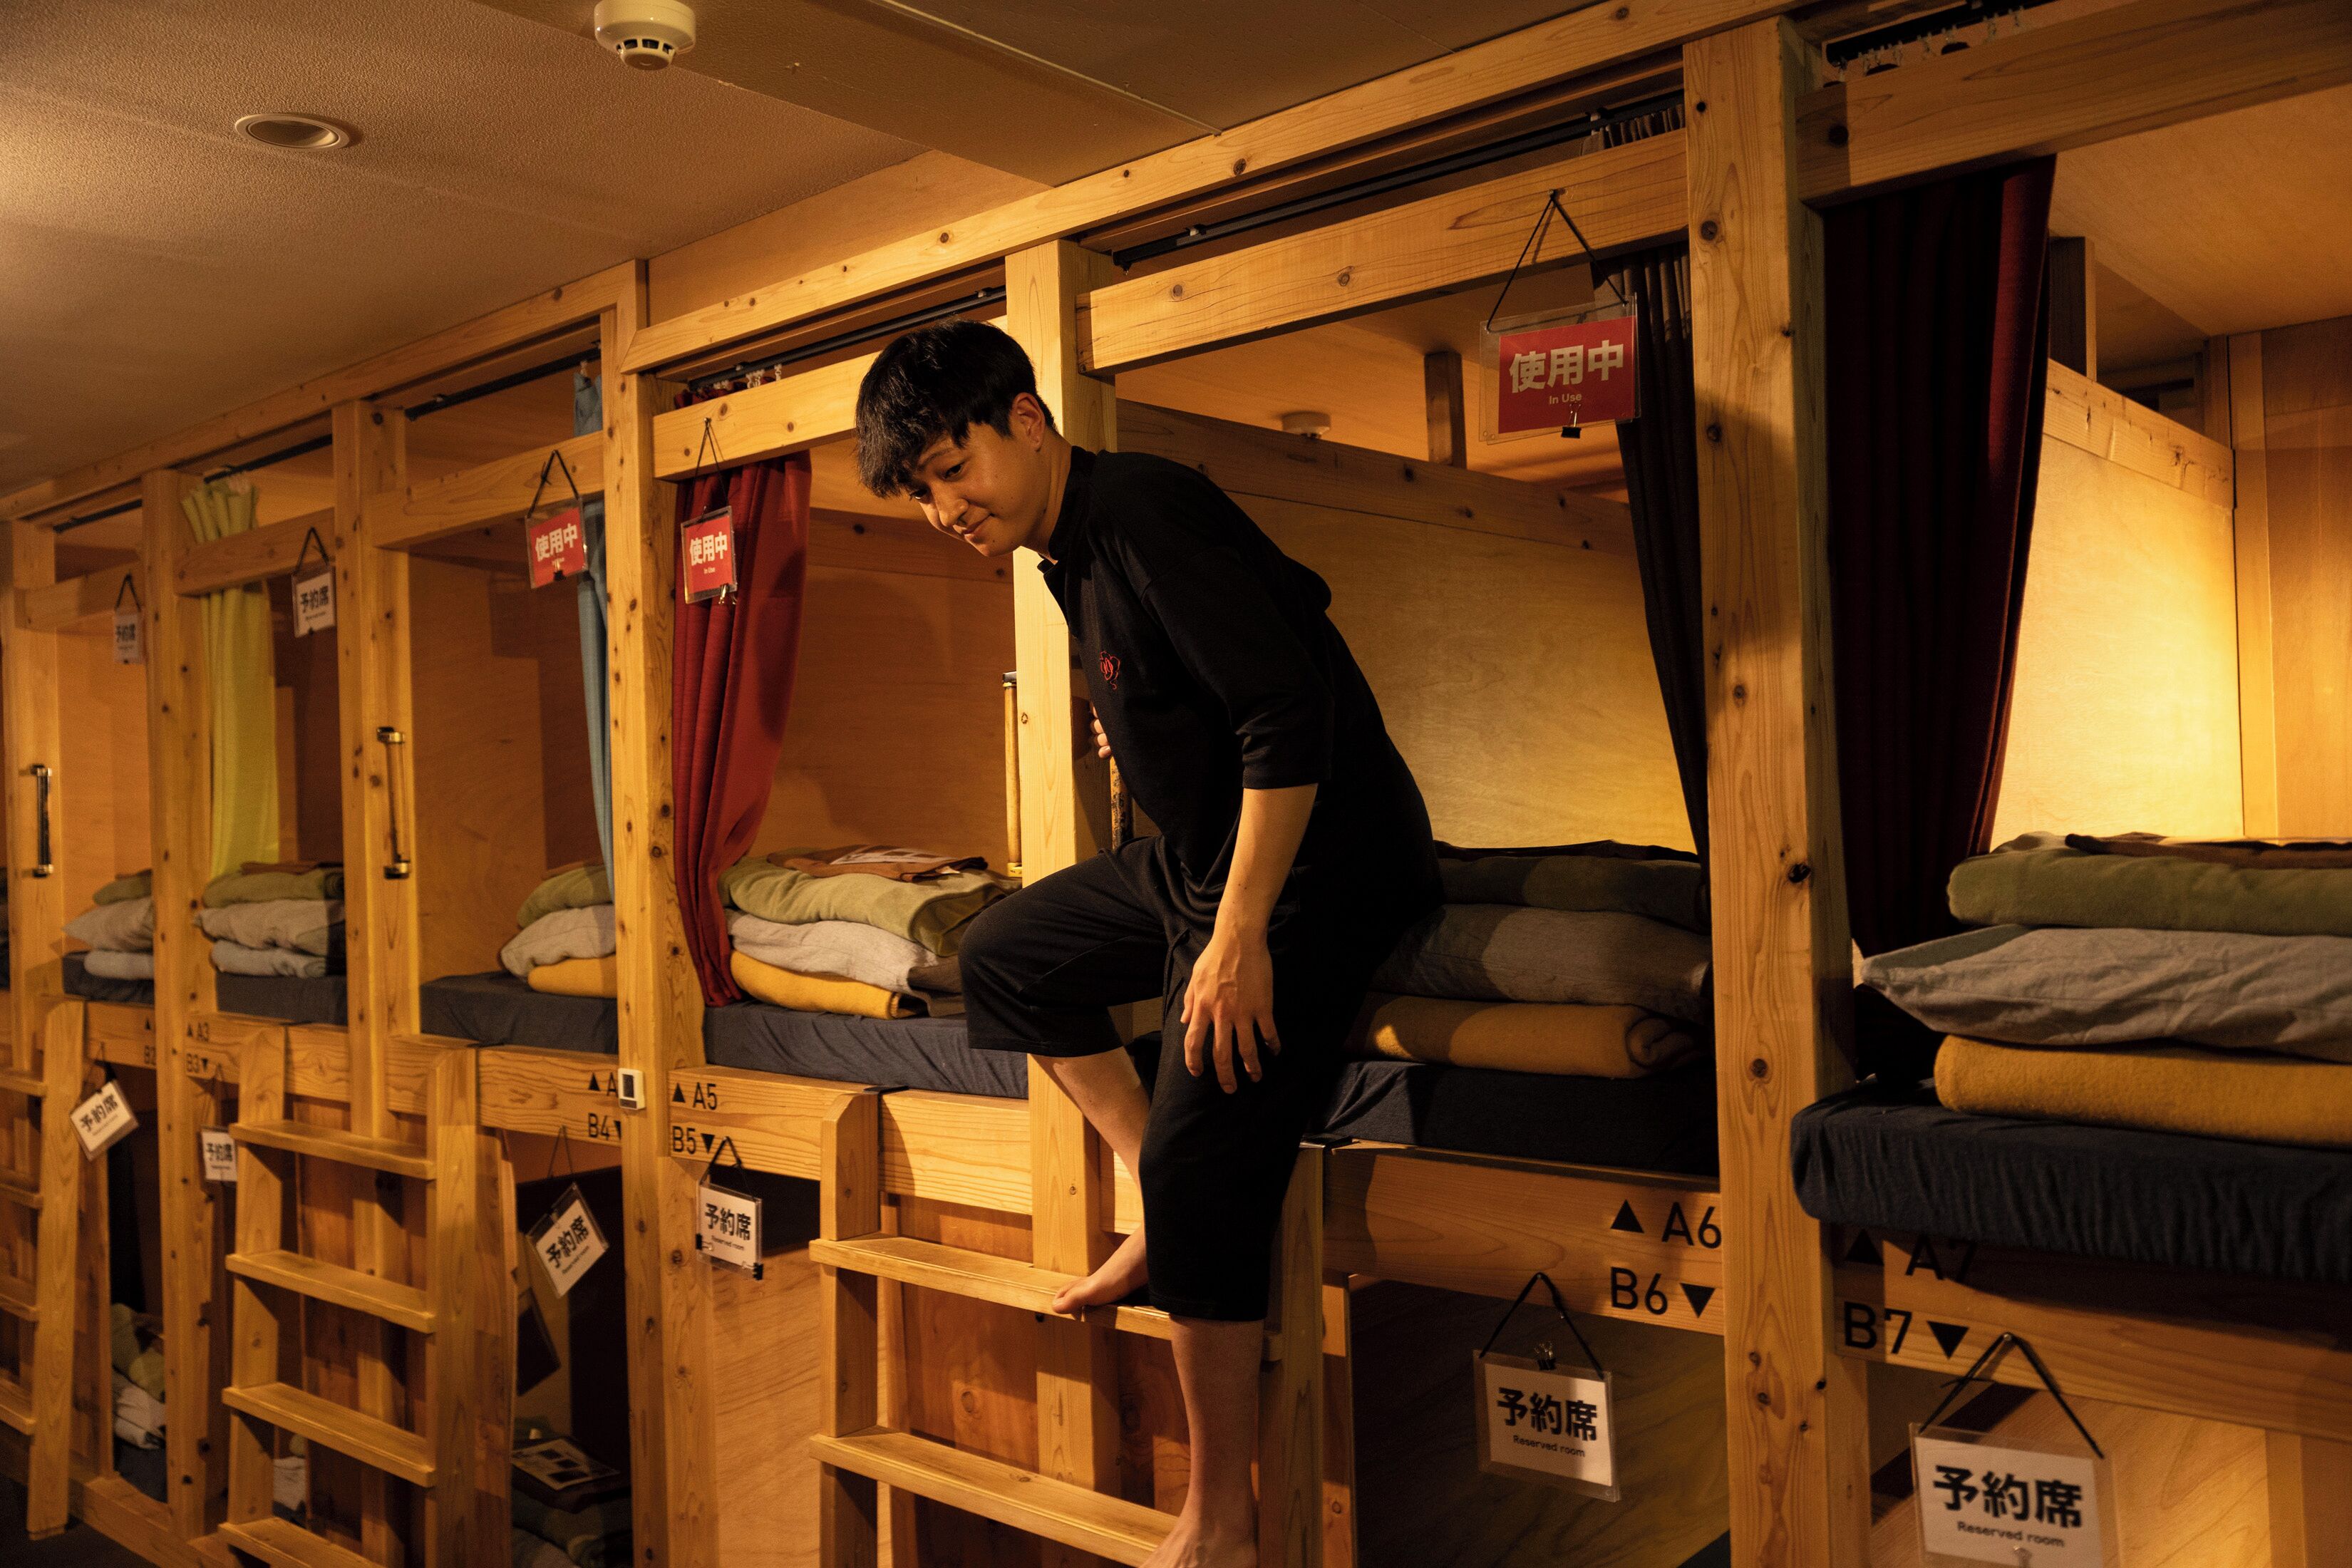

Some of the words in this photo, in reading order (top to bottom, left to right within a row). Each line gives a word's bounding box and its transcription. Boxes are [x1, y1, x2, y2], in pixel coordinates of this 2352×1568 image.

[1509, 339, 1624, 393] 使用中
[1549, 396, 1559, 405] In
[1562, 393, 1582, 403] Use
[535, 523, 578, 562] 使用中
[689, 531, 728, 566] 使用中
[607, 1072, 619, 1098] A
[693, 1082, 718, 1110] A5
[80, 1093, 118, 1132] 予約席
[588, 1113, 610, 1140] B4
[673, 1125, 697, 1154] B5
[705, 1202, 751, 1241] 予約席
[1661, 1202, 1722, 1249] A6
[547, 1215, 589, 1268] 予約席
[1906, 1234, 1977, 1284] A7
[1611, 1267, 1668, 1315] B6
[1845, 1301, 1912, 1354] B7
[1497, 1387, 1597, 1441] 予約席
[1513, 1435, 1557, 1452] Reserved
[1560, 1447, 1585, 1458] room
[1934, 1465, 2082, 1528] 予約席
[1958, 1521, 2022, 1541] Reserved
[2027, 1535, 2065, 1547] room
